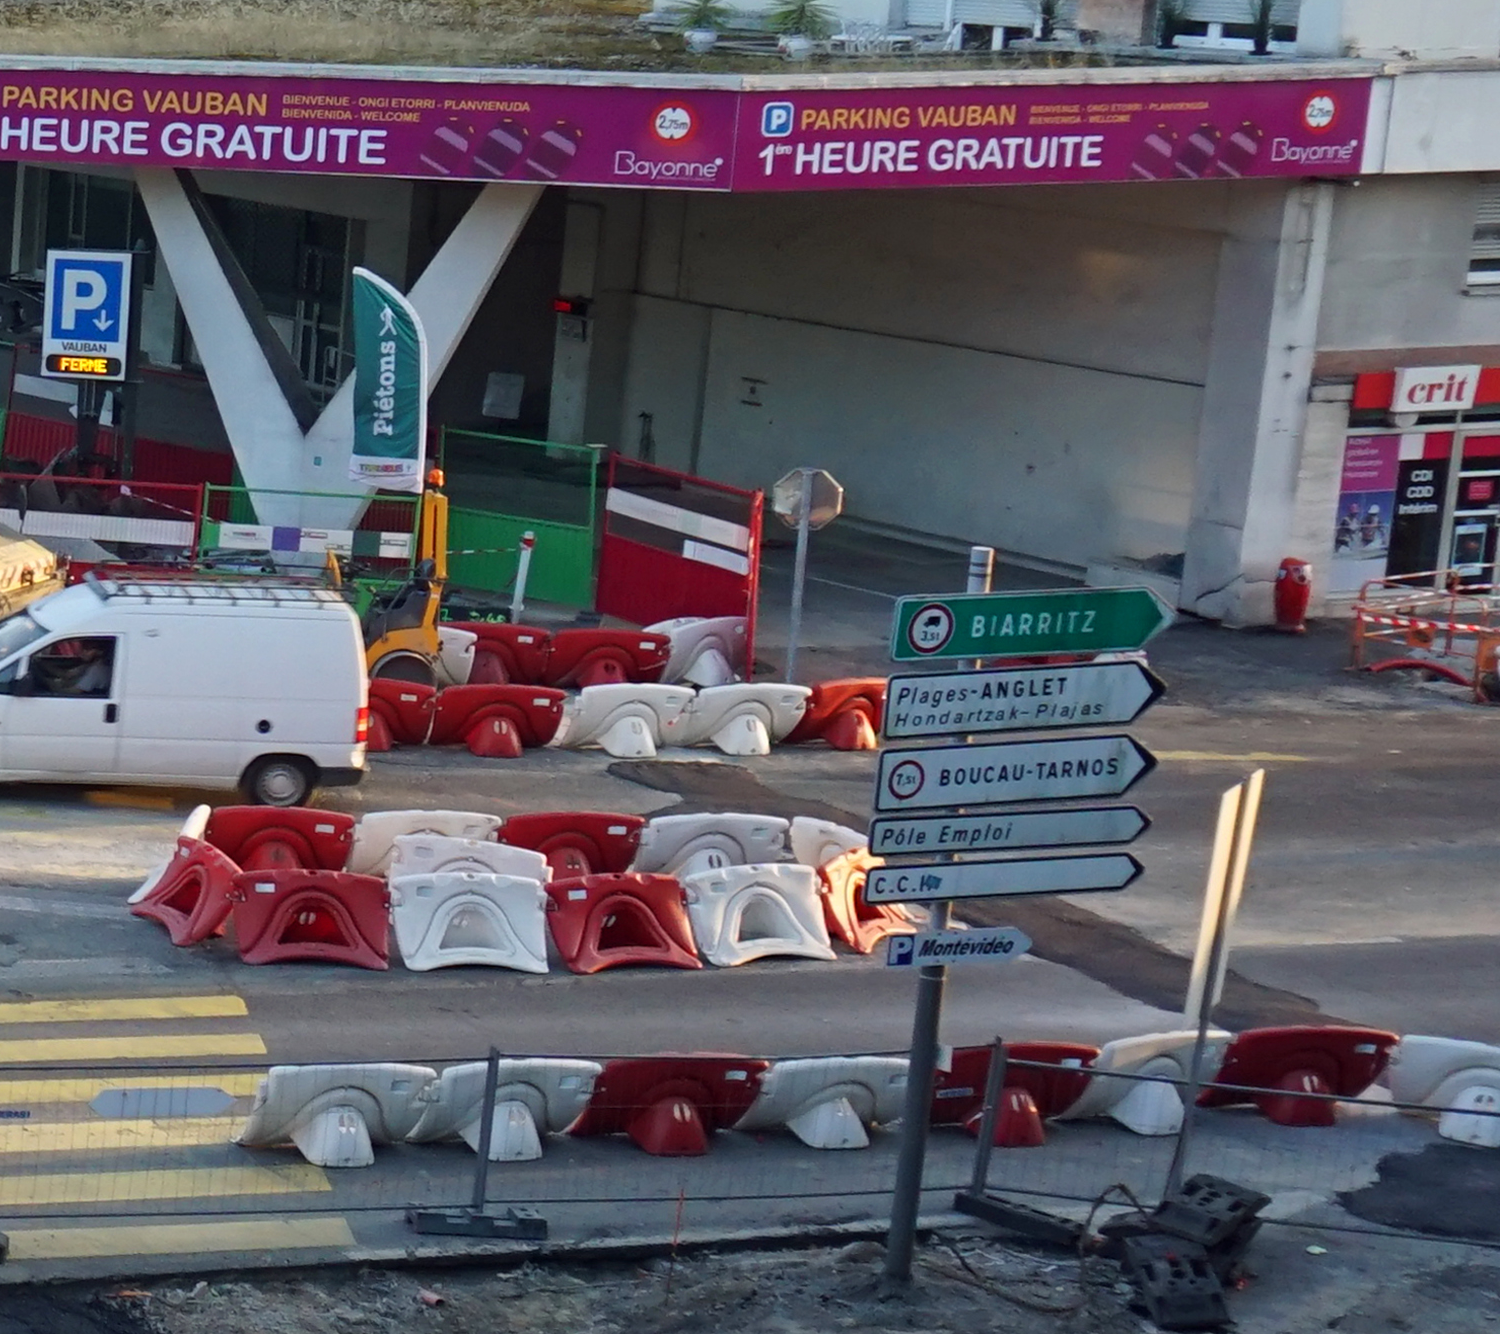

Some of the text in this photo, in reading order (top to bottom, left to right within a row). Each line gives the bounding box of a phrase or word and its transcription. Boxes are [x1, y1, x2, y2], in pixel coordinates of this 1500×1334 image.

[1, 85, 134, 113] PARKING
[143, 89, 268, 117] VAUBAN
[281, 108, 421, 122] BIENVENIDA WELCOME
[282, 94, 350, 107] BIENVENUE
[358, 97, 389, 108] ONGI
[391, 98, 435, 109] ETORRI
[801, 107, 911, 130] PARKING
[917, 105, 1017, 128] VAUBAN
[0, 116, 150, 156] HEURE
[160, 122, 388, 165] GRATUITE
[794, 139, 921, 175] HEURE
[927, 135, 1105, 172] GRATUITE
[1271, 137, 1358, 165] Bayonne
[614, 150, 724, 179] Bayonne
[62, 341, 107, 353] VAUBAN
[60, 356, 108, 373] FERME
[373, 340, 397, 436] Piétons
[1407, 373, 1468, 404] crit
[970, 610, 1097, 639] BIARRITZ
[896, 677, 1067, 708] Plages-ANGLET
[938, 757, 1120, 787] BOUCAU-TARNOS
[938, 822, 1013, 846] Emploi
[917, 937, 1014, 958] Montévidéo
